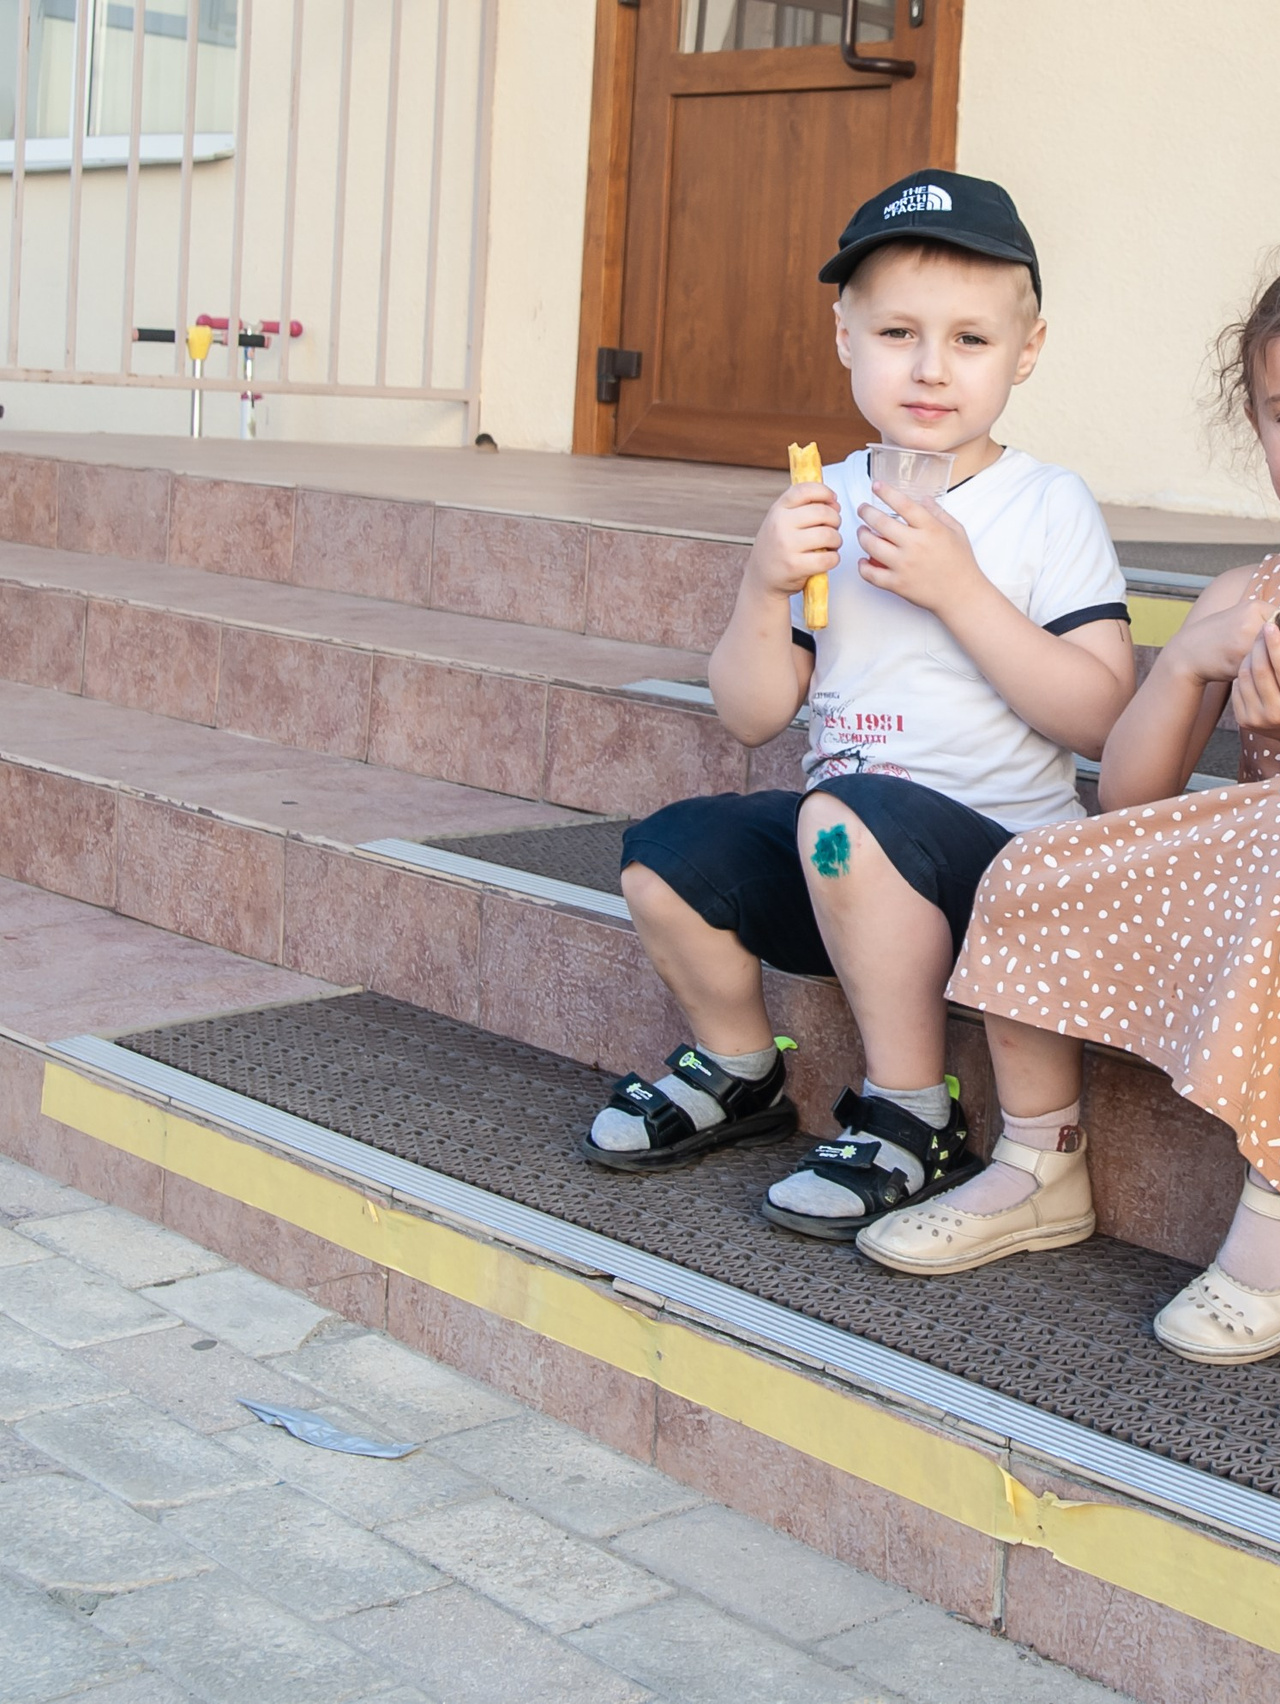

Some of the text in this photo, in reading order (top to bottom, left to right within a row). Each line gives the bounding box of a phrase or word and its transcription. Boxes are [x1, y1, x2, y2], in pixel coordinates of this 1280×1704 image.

[902, 186, 927, 197] THE
[883, 194, 926, 215] NORTH
[891, 202, 926, 217] FACE
[855, 713, 904, 732] 1981
